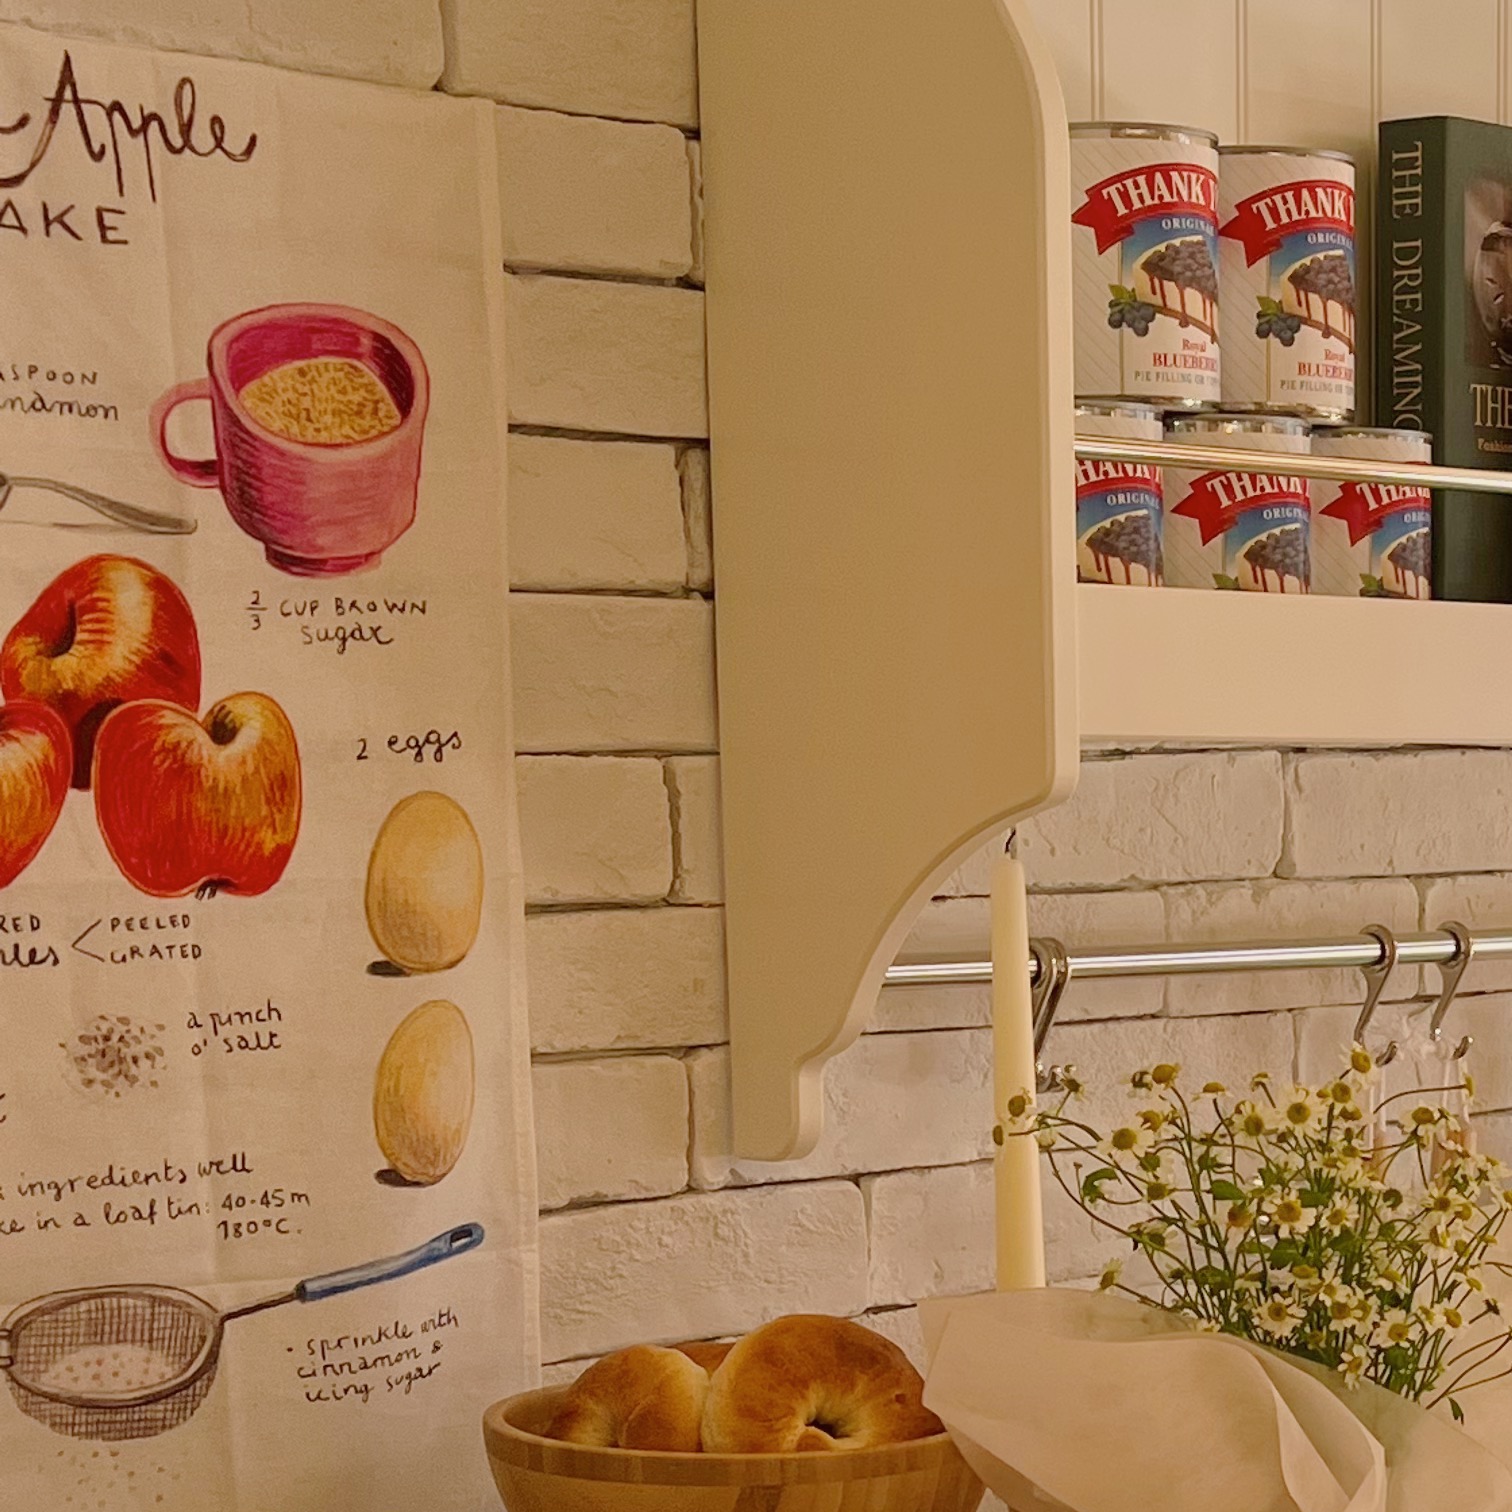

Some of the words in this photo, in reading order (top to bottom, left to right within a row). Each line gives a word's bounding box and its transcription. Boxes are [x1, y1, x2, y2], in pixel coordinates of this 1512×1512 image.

[0, 50, 257, 202] Apple
[1101, 171, 1205, 217] THANK
[1392, 141, 1422, 219] THE
[1251, 187, 1349, 231] THANK
[279, 599, 320, 618] CUP
[334, 597, 427, 616] BROWN
[356, 739, 369, 760] 2
[387, 729, 463, 763] eggs
[111, 914, 190, 932] PEELED
[110, 944, 202, 964] GRATED
[187, 1012, 203, 1029] a
[209, 999, 282, 1033] pinch
[224, 1031, 281, 1052] salt
[17, 1165, 187, 1201] ingredients
[198, 1152, 253, 1178] well
[36, 1211, 61, 1231] in
[73, 1214, 91, 1227] a
[103, 1200, 157, 1225] loaf
[307, 1321, 413, 1361] sprinkle
[420, 1307, 459, 1333] with
[297, 1346, 422, 1378] cinnamon
[303, 1383, 375, 1404] icing
[386, 1362, 441, 1395] sugar
